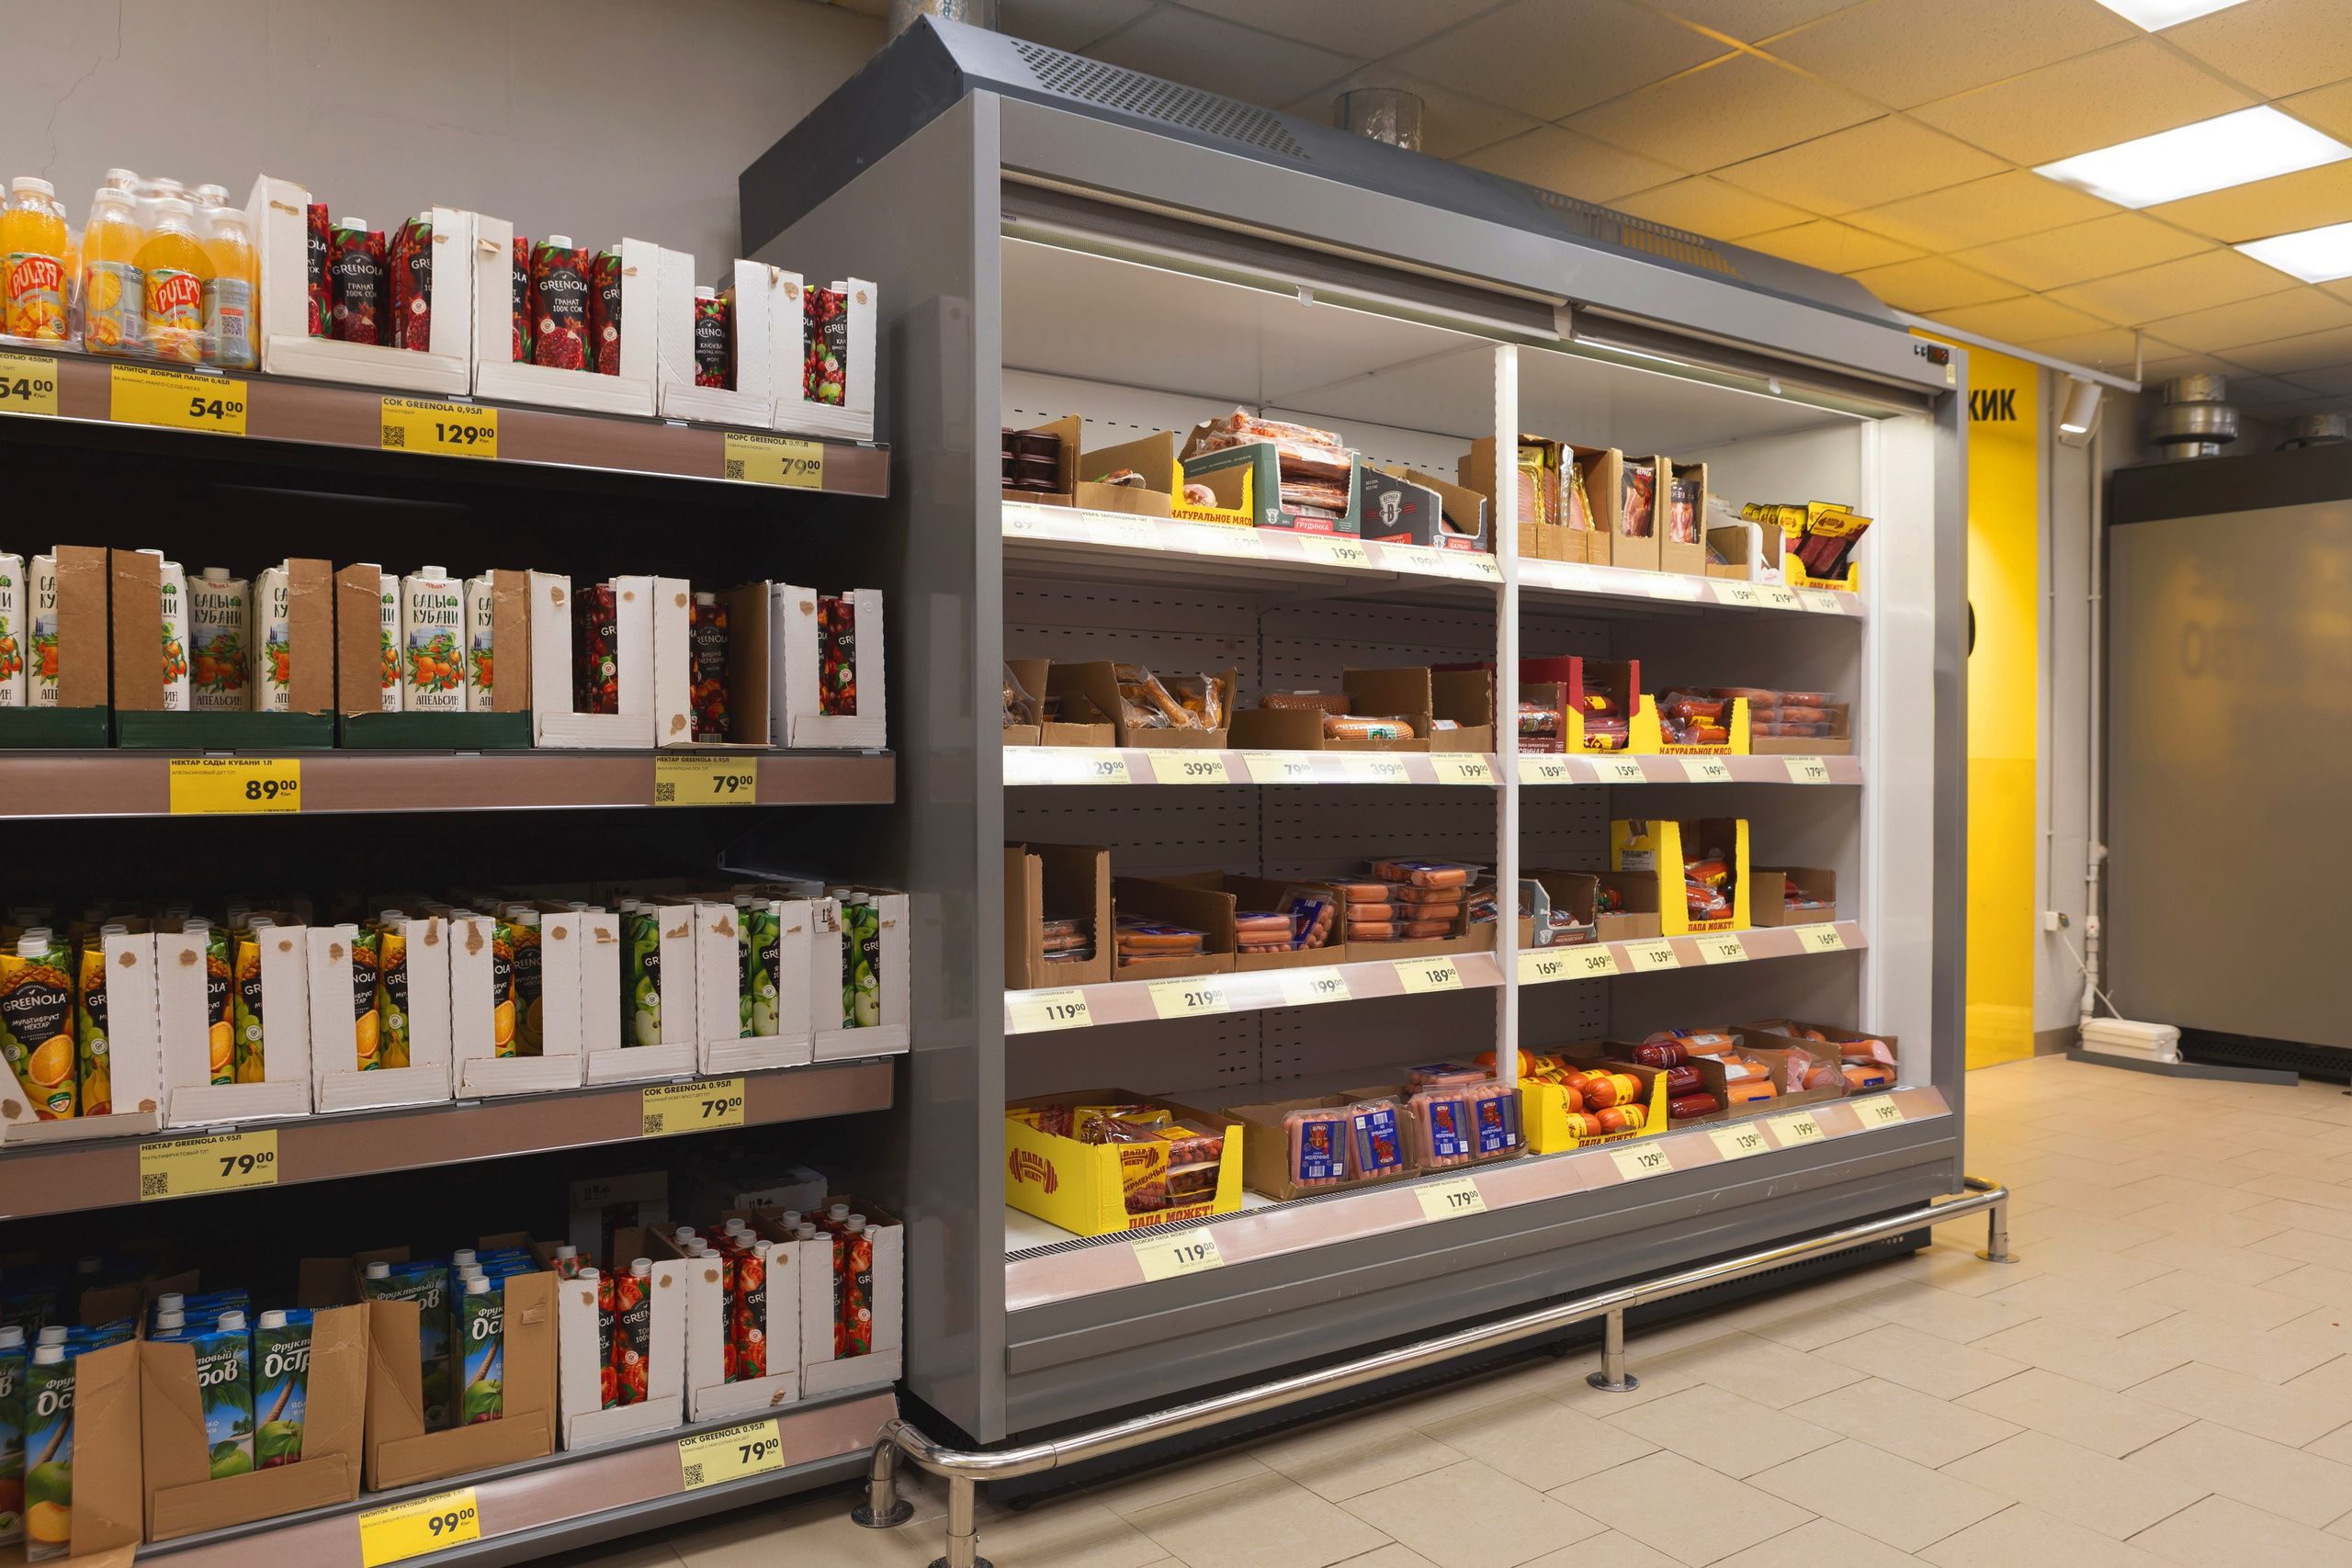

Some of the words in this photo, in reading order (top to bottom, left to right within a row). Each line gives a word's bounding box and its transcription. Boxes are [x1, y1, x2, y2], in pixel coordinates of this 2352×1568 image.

[333, 265, 383, 276] GREENOLA
[13, 261, 57, 298] PULPY
[540, 280, 588, 293] GREENOLA
[159, 278, 200, 311] PULPY
[114, 366, 149, 374] НАПИТОК
[151, 369, 182, 378] ДОБРЫЙ
[0, 378, 32, 400] 54
[33, 380, 53, 391] 00
[189, 397, 224, 420] 54
[225, 401, 243, 412] 00
[383, 398, 402, 406] СОК
[406, 400, 454, 412] GREENOLA
[458, 406, 482, 415] 0,95Л
[435, 423, 478, 445] 129
[480, 428, 494, 437] 00
[727, 434, 748, 442] МОРС
[751, 435, 786, 446] GREENOLA
[782, 458, 807, 476] 79
[808, 460, 820, 469] 00
[1233, 516, 1252, 525] МЯСО
[1296, 522, 1329, 531] ГРУДИНКА
[1331, 547, 1356, 559] 199
[195, 593, 231, 609] САДЫ
[413, 593, 446, 609] САДЫ
[1772, 593, 1791, 603] 219
[195, 609, 242, 625] КУБАНИ
[413, 610, 458, 625] КУБАНИ
[197, 695, 242, 705] АПЕЛЬСИН
[416, 695, 458, 706] АПЕЛЬСИН
[1659, 747, 1713, 755] НАТУРАЛЬНОЕ
[1713, 747, 1732, 755] МЯСО
[1183, 762, 1213, 775] 399
[1283, 764, 1302, 775] 79
[1370, 763, 1396, 775] 399
[1458, 764, 1481, 777] 199
[1539, 766, 1559, 777] 189
[1615, 766, 1634, 775] 159
[1702, 766, 1721, 775] 149
[1805, 767, 1821, 777] 179
[245, 781, 278, 800] 89
[280, 781, 297, 790] 00
[713, 775, 739, 793] 79
[740, 775, 752, 784] 00
[1688, 922, 1706, 931] ПАПА
[1708, 921, 1734, 930] МОЖЕТ!
[1817, 934, 1834, 944] 169
[1719, 945, 1736, 955] 129
[1585, 956, 1606, 968] 349
[1650, 952, 1668, 962] 139
[1536, 963, 1556, 975] 169
[1425, 970, 1448, 983] 189
[1310, 980, 1335, 994] 199
[3, 993, 66, 1011] GREENOLA
[1184, 990, 1213, 1007] 219
[1046, 1004, 1076, 1021] 119
[1075, 1003, 1086, 1011] 00
[12, 1013, 60, 1027] МУЛЬТИФРУКТ
[24, 1021, 51, 1032] НЕКТАР
[664, 1084, 707, 1094] GREENOLA
[709, 1080, 731, 1089] 0.95Л
[702, 1099, 728, 1118] 79
[729, 1097, 742, 1107] 00
[1875, 1107, 1894, 1119] 199
[1482, 1127, 1502, 1135] МОЛОЧНЫЕ
[1793, 1123, 1813, 1136] 199
[141, 1142, 173, 1151] НЕКТАР
[175, 1137, 217, 1147] GREENOLA
[1578, 1138, 1600, 1147] ПАПА
[1604, 1132, 1637, 1143] МОЖЕТ!
[1736, 1134, 1756, 1148] 139
[142, 1150, 199, 1160] МУЛЬТИФРУКТОВЫЙ
[1022, 1150, 1043, 1168] ПАПА
[1123, 1148, 1147, 1157] ПАПА
[220, 1155, 254, 1177] 79
[256, 1152, 274, 1163] 00
[1124, 1158, 1144, 1167] МОЖЕТ
[1637, 1154, 1659, 1168] 129
[1024, 1170, 1042, 1183] МОЖЕТ
[1447, 1192, 1470, 1207] 179
[1129, 1214, 1161, 1229] ПАПА
[1166, 1204, 1214, 1223] МОЖЕТ!
[1174, 1245, 1204, 1264] 119
[1204, 1242, 1215, 1250] 00
[377, 1280, 436, 1302] Фруктовый
[680, 1438, 696, 1447] СОК
[699, 1428, 741, 1442] GREENOLA
[742, 1422, 764, 1433] 0.95Л
[682, 1445, 706, 1453] ТОМАТНЫЙ
[740, 1442, 764, 1463] 79
[765, 1438, 779, 1450] 00
[360, 1507, 389, 1519] НАПИТОК
[390, 1499, 427, 1511] ФРУКТОВЫЙ
[429, 1493, 451, 1502] ОСТРОВ
[429, 1512, 458, 1537] 99
[459, 1508, 475, 1519] 00
